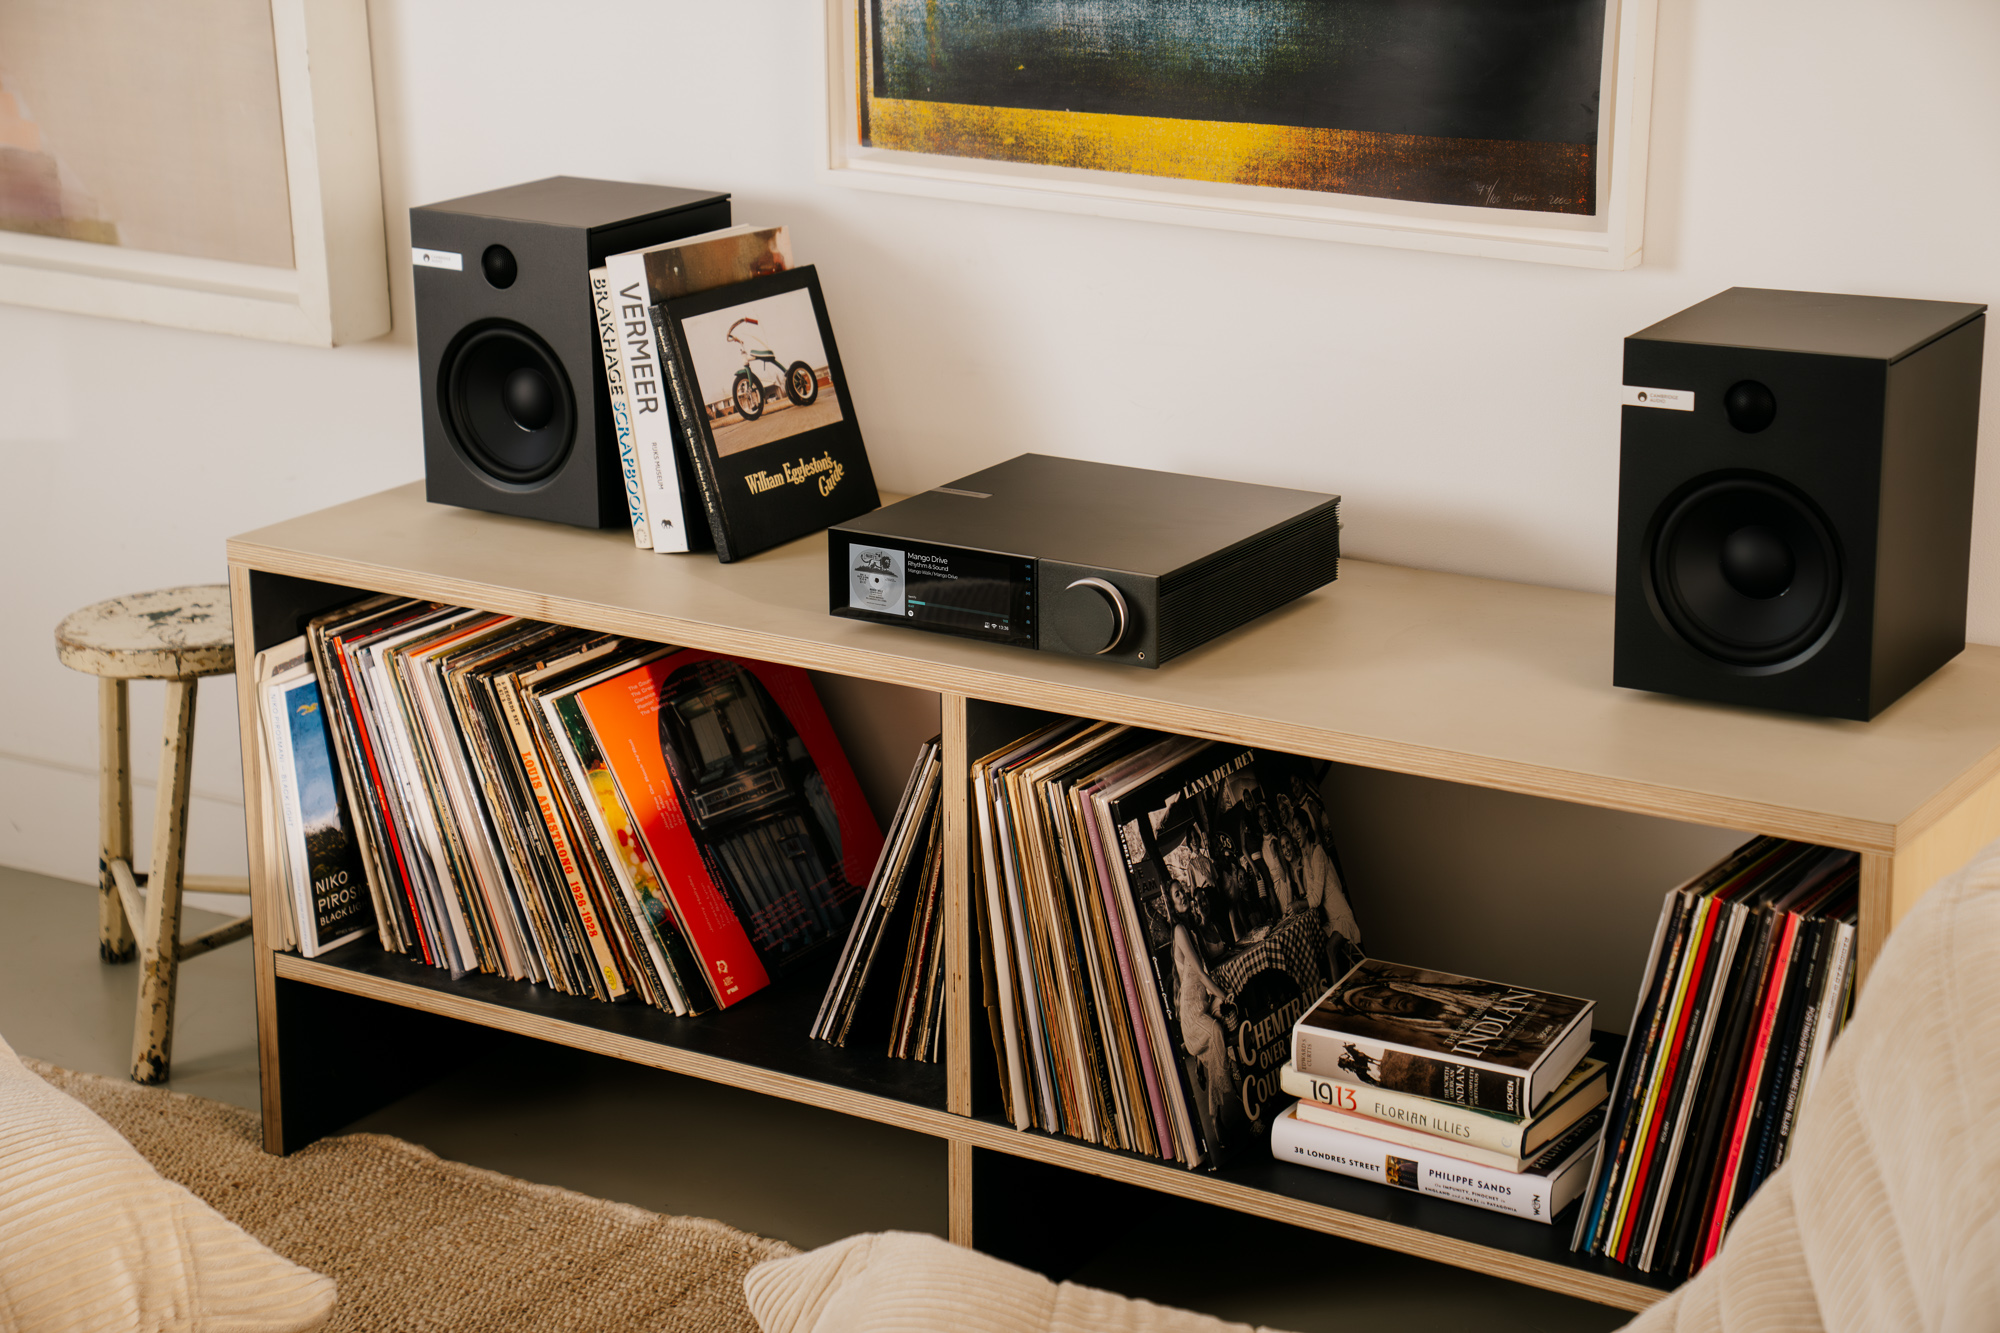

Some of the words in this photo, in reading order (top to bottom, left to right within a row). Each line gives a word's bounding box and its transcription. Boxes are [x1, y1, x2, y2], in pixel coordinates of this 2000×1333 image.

[620, 282, 658, 414] VERMEER
[594, 278, 624, 396] BRAKHAGE
[614, 401, 644, 527] SCRAPBOOK
[652, 460, 666, 490] MUSEUM
[744, 470, 786, 494] William
[782, 450, 832, 485] Eggleston's
[818, 460, 844, 496] Guide
[908, 552, 930, 562] Mango
[932, 556, 948, 564] Drive
[908, 561, 928, 570] Rhythm
[500, 685, 517, 712] RECORDS
[512, 714, 520, 726] SET
[639, 708, 651, 716] The
[646, 783, 655, 794] De
[1183, 774, 1212, 800] LANA
[1212, 762, 1234, 783] DEL
[1234, 750, 1255, 770] REY
[522, 752, 542, 789] LOUIS
[537, 795, 574, 875] ARMSTRONG
[703, 843, 717, 868] Lovers
[316, 871, 348, 894] NIKO
[714, 869, 730, 899] Modern
[320, 908, 348, 926] BLACK
[1834, 936, 1850, 983] RADIOHEAD
[1450, 988, 1537, 1058] INDIAN
[1794, 1005, 1815, 1068] POSTINDUSTRIAL
[1260, 1039, 1288, 1070] OVER
[1456, 1065, 1465, 1104] INDIAN
[1785, 1068, 1802, 1111] HOMETOWN
[1310, 1080, 1357, 1111] 1913
[1375, 1102, 1427, 1126] FLORIAN
[1433, 1118, 1470, 1138] ILLIES
[1779, 1111, 1792, 1136] BLUES
[1294, 1146, 1304, 1155] 38
[1306, 1149, 1346, 1164] LONDRES
[1349, 1158, 1380, 1172] STREET
[1429, 1169, 1474, 1187] PHILIPPE
[1478, 1181, 1512, 1196] SANDS
[1425, 1186, 1450, 1196] ENGLAND
[1487, 1201, 1518, 1213] PATAGONIA
